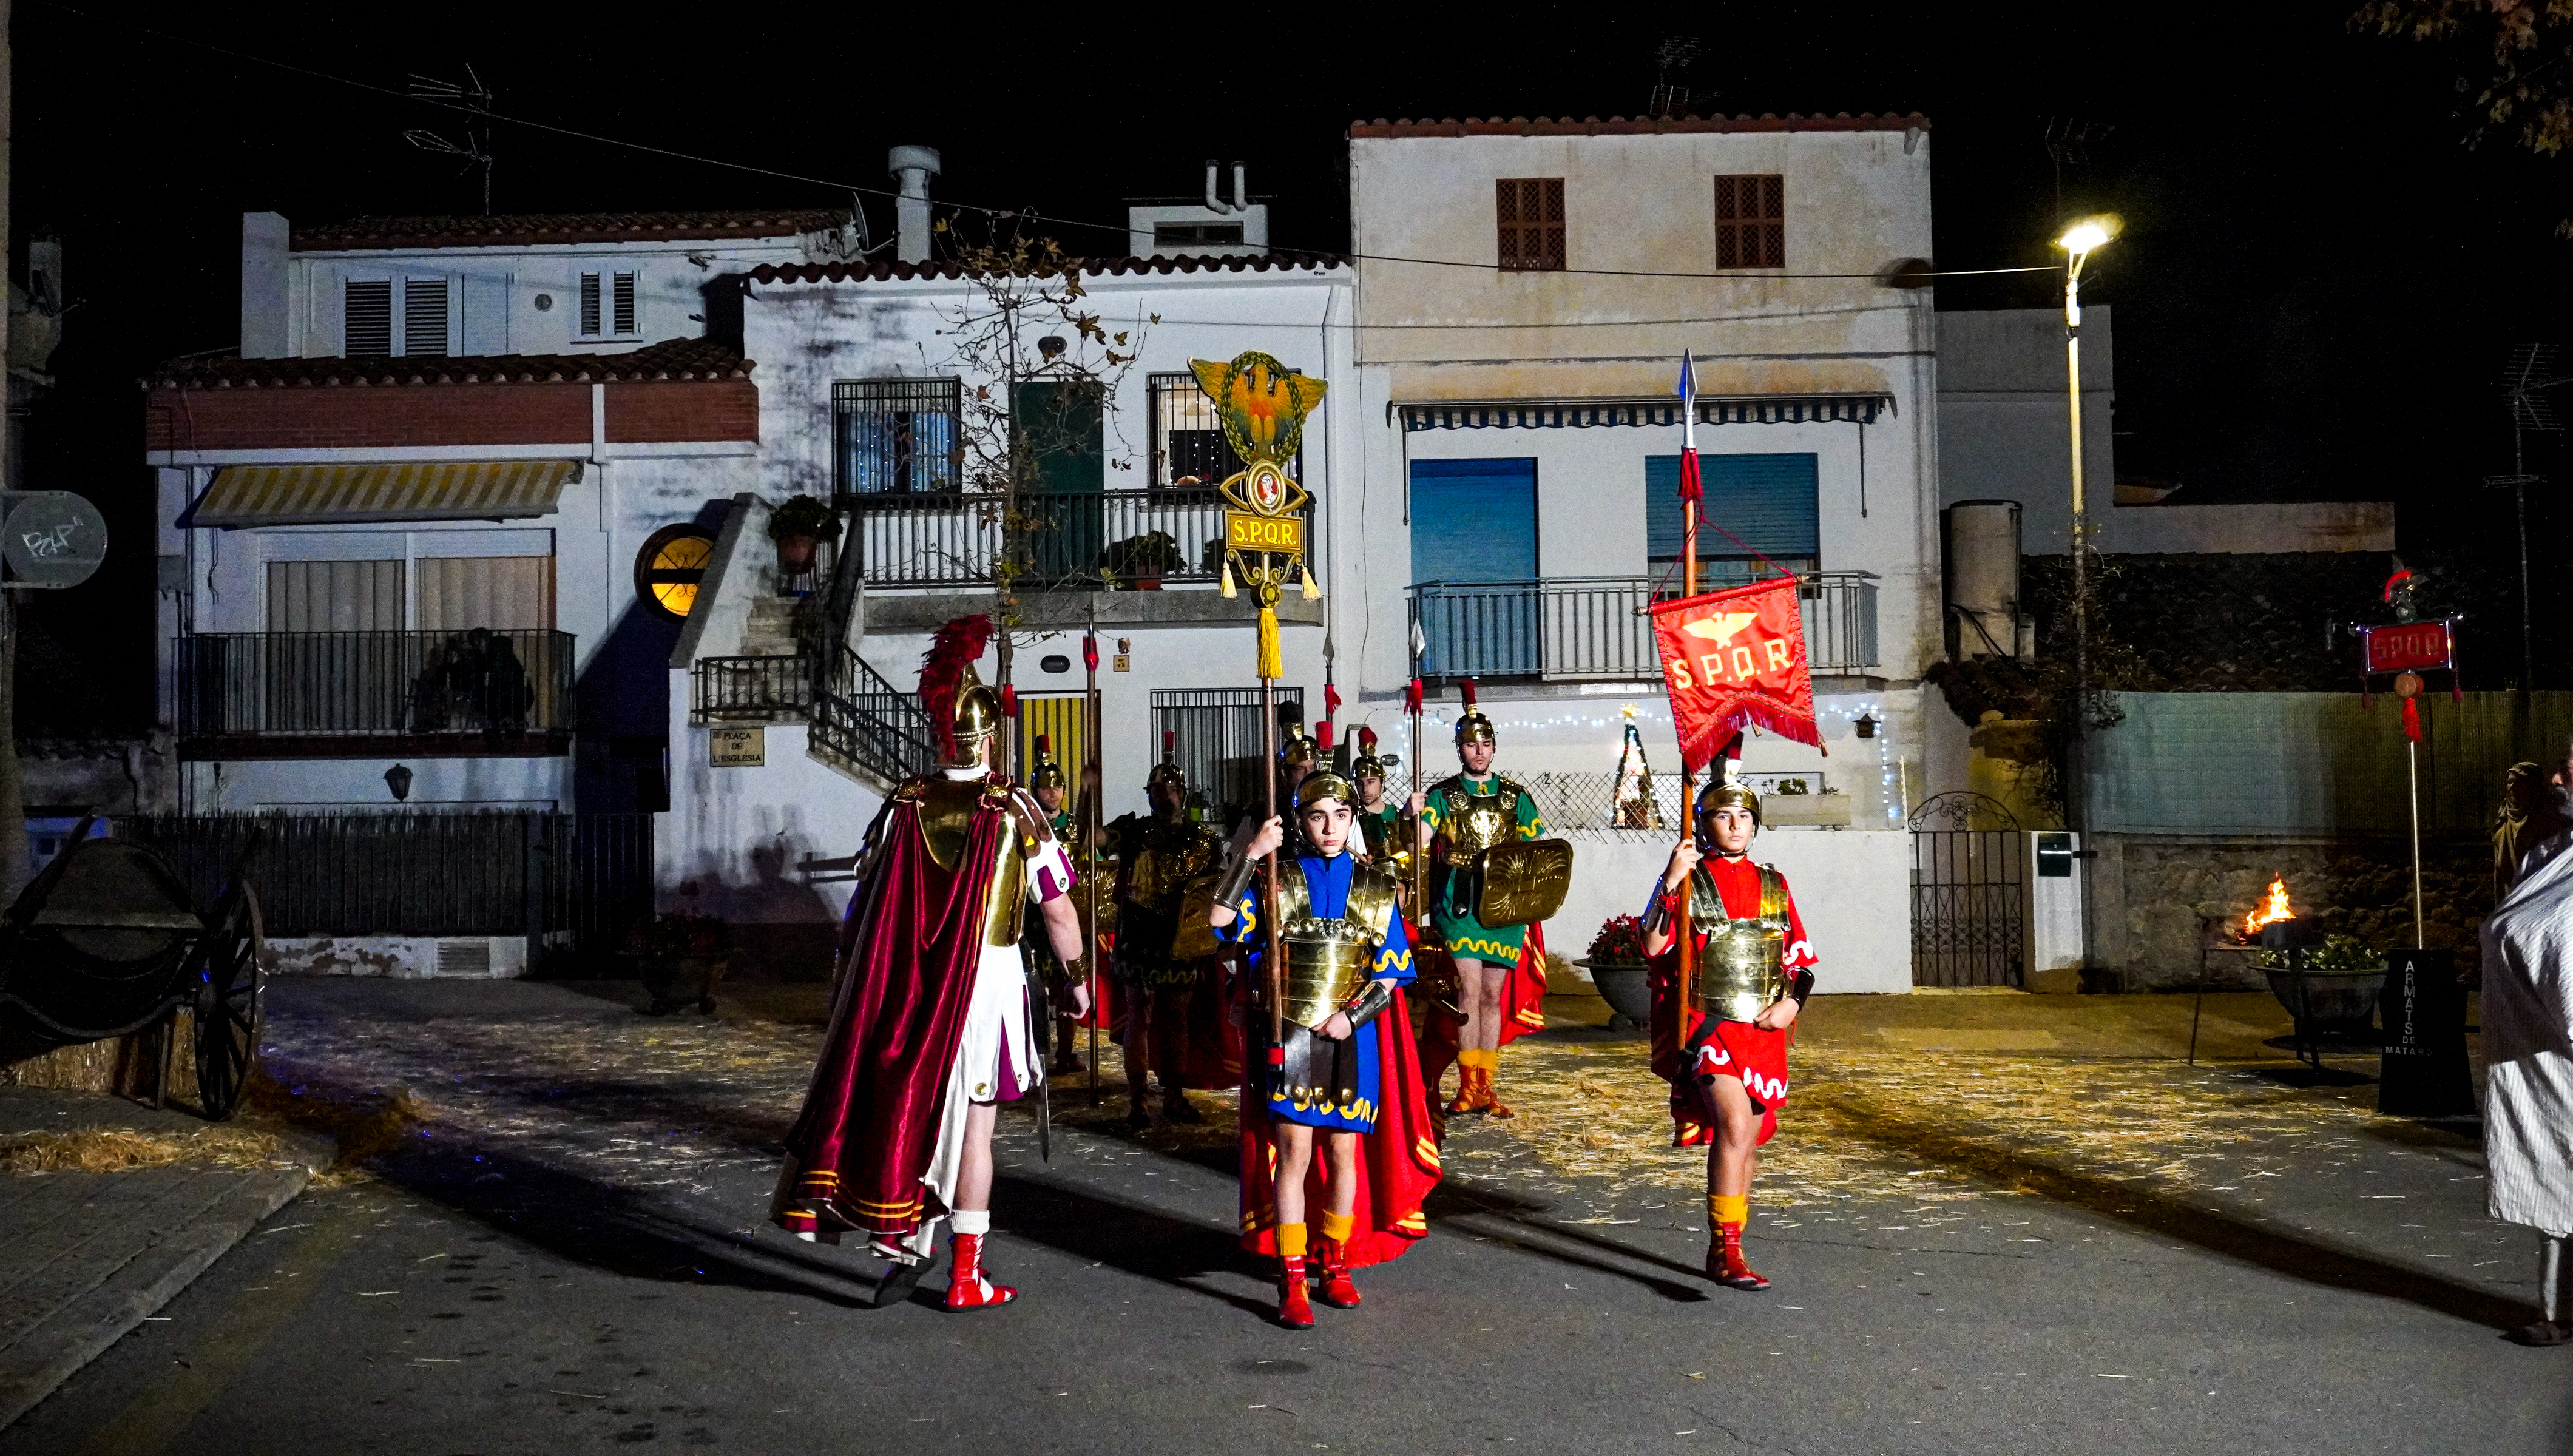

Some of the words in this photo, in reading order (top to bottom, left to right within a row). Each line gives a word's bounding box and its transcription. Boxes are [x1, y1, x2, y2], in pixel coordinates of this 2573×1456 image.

[1234, 520, 1296, 545] S.P.Q.R.
[2404, 960, 2416, 1034] ARMATS
[2402, 1036, 2415, 1044] DE
